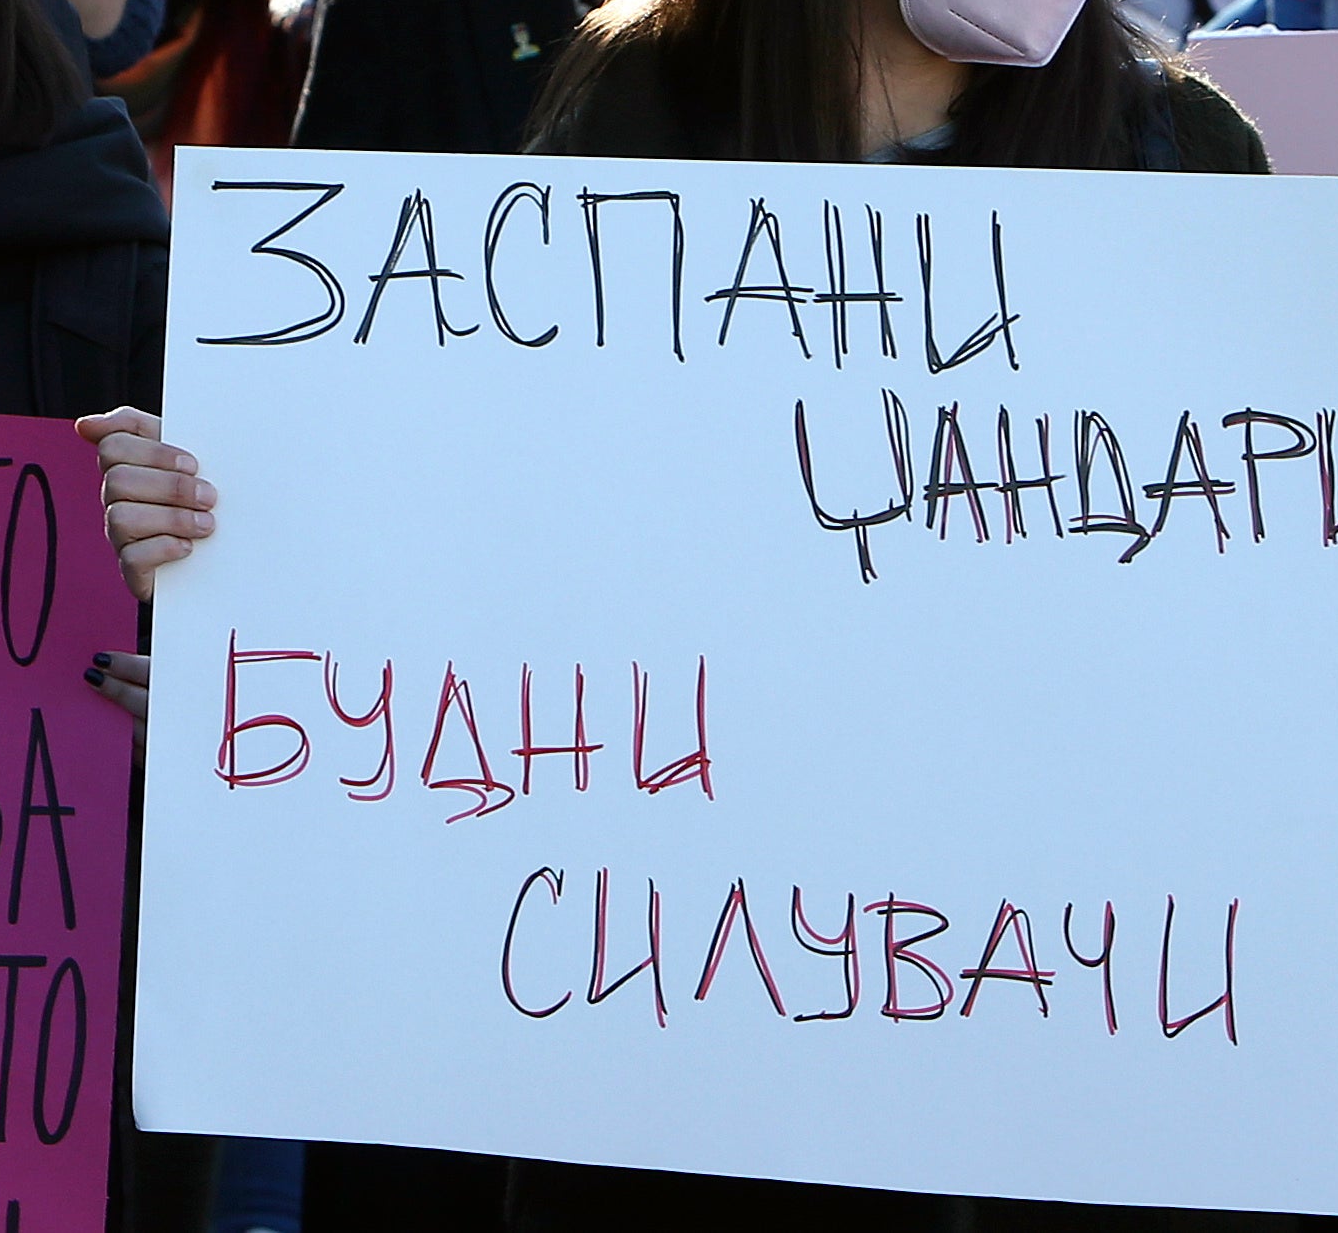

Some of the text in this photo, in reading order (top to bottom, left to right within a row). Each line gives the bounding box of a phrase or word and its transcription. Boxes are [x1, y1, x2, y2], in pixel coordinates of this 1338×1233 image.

[196, 181, 1021, 373] ЗАСПАНИ
[215, 627, 715, 824] БУДНИ
[501, 865, 1240, 1047] СИЛУВАЧИ
